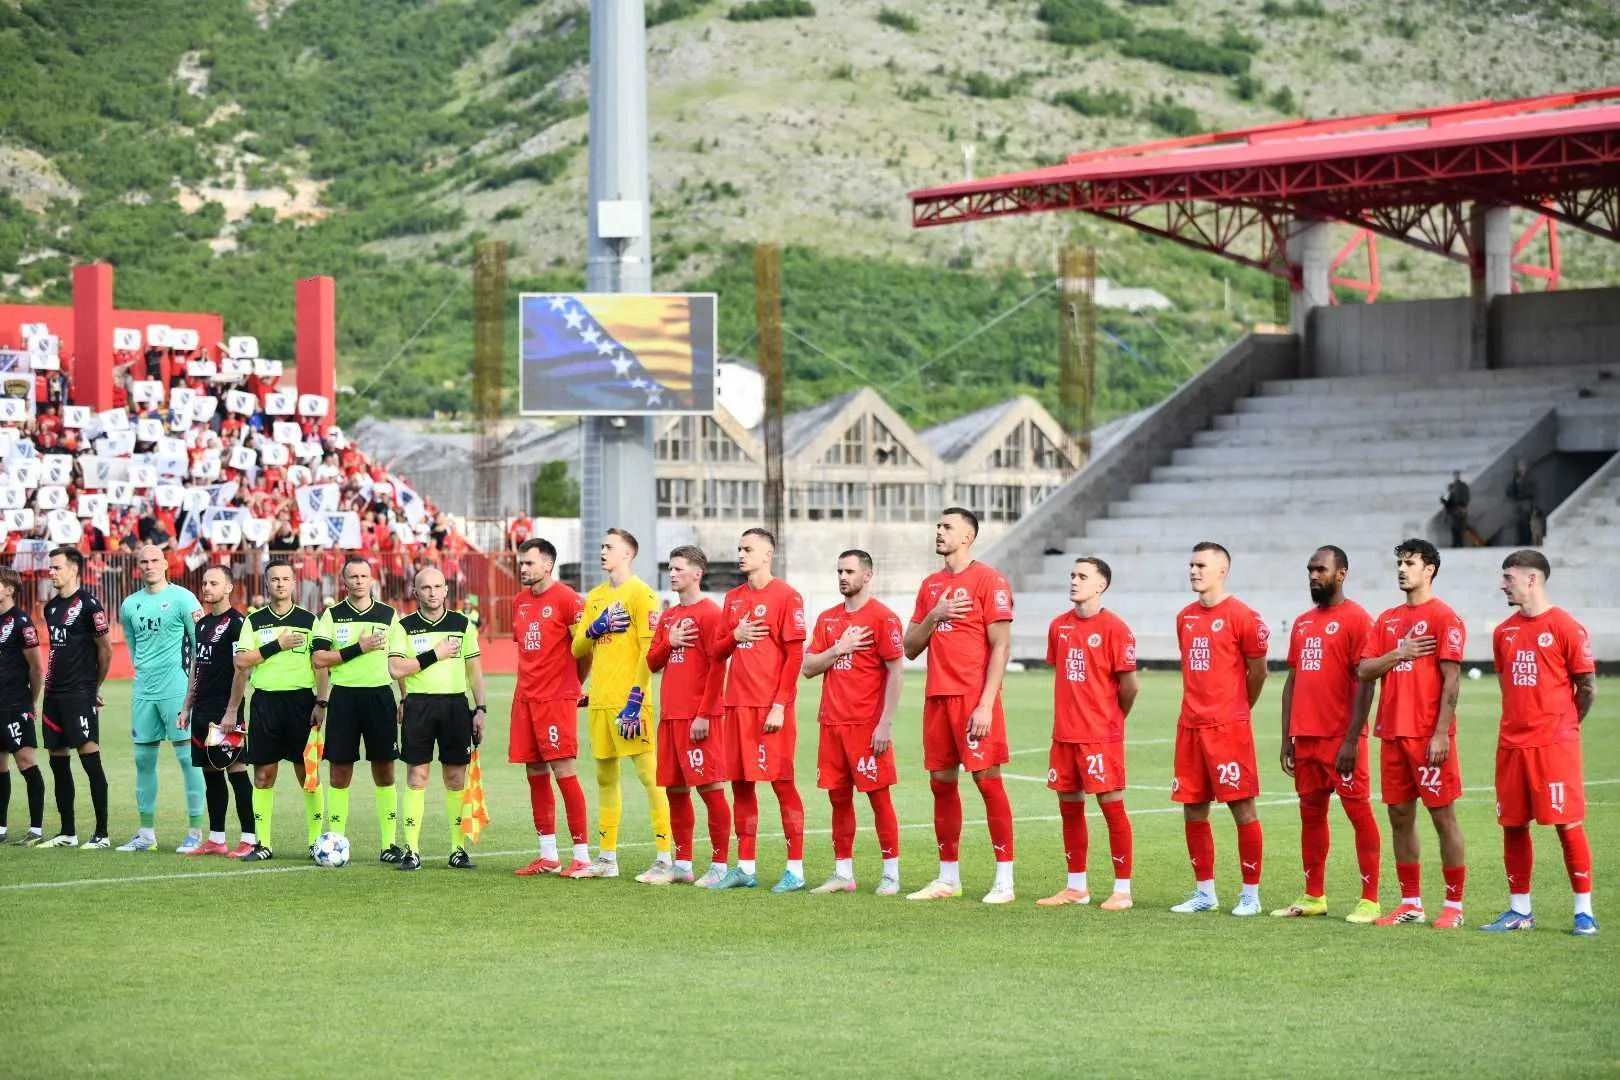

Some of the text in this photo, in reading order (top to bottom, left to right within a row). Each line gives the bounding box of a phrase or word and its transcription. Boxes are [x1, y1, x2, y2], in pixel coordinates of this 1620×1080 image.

[1193, 636, 1209, 648] na
[1305, 636, 1321, 648] na
[1069, 648, 1084, 659] na
[1189, 648, 1210, 659] ren
[1301, 648, 1322, 660] ren
[1516, 649, 1535, 662] na
[1066, 658, 1085, 671] ren
[1190, 657, 1210, 671] tas
[1301, 657, 1321, 671] tas
[1512, 661, 1537, 674] ren
[1066, 669, 1086, 682] tas
[1513, 671, 1537, 687] tas
[8, 721, 23, 738] 12
[80, 715, 89, 730] 4
[548, 725, 559, 743] 8
[687, 748, 704, 768] 19
[758, 744, 766, 763] 5
[857, 755, 878, 775] 44
[1086, 753, 1104, 775] 21
[1216, 761, 1241, 784] 29
[1418, 766, 1443, 786] 22
[1548, 782, 1564, 804] 11
